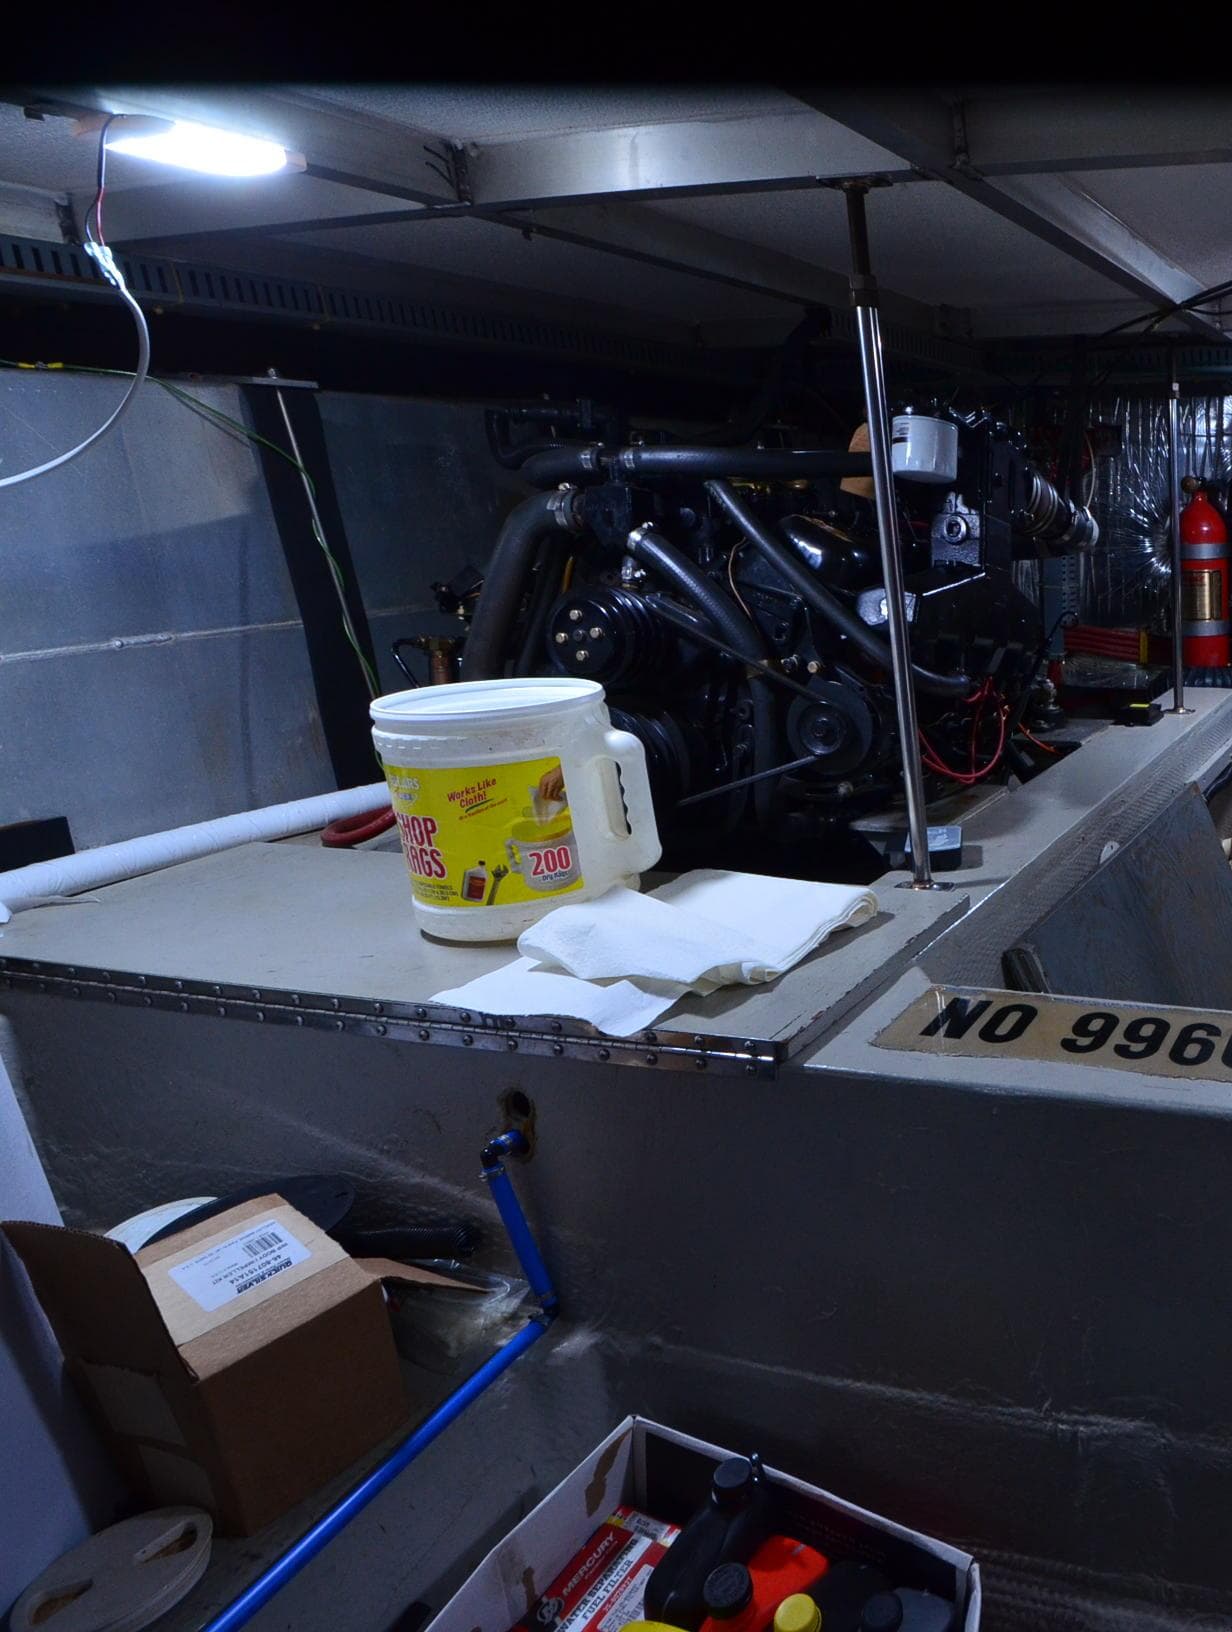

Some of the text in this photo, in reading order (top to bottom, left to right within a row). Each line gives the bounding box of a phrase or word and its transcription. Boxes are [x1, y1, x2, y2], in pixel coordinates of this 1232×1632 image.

[448, 778, 496, 802] Works Like
[460, 791, 487, 808] Cloth!
[528, 846, 571, 876] 200
[920, 997, 1039, 1044] NO
[236, 1260, 293, 1294] QUICKSILVER
[562, 1530, 615, 1597] MERCURY
[588, 1538, 638, 1598] SEPARATING
[581, 1593, 606, 1620] FUEL
[604, 1559, 634, 1594] FILTER
